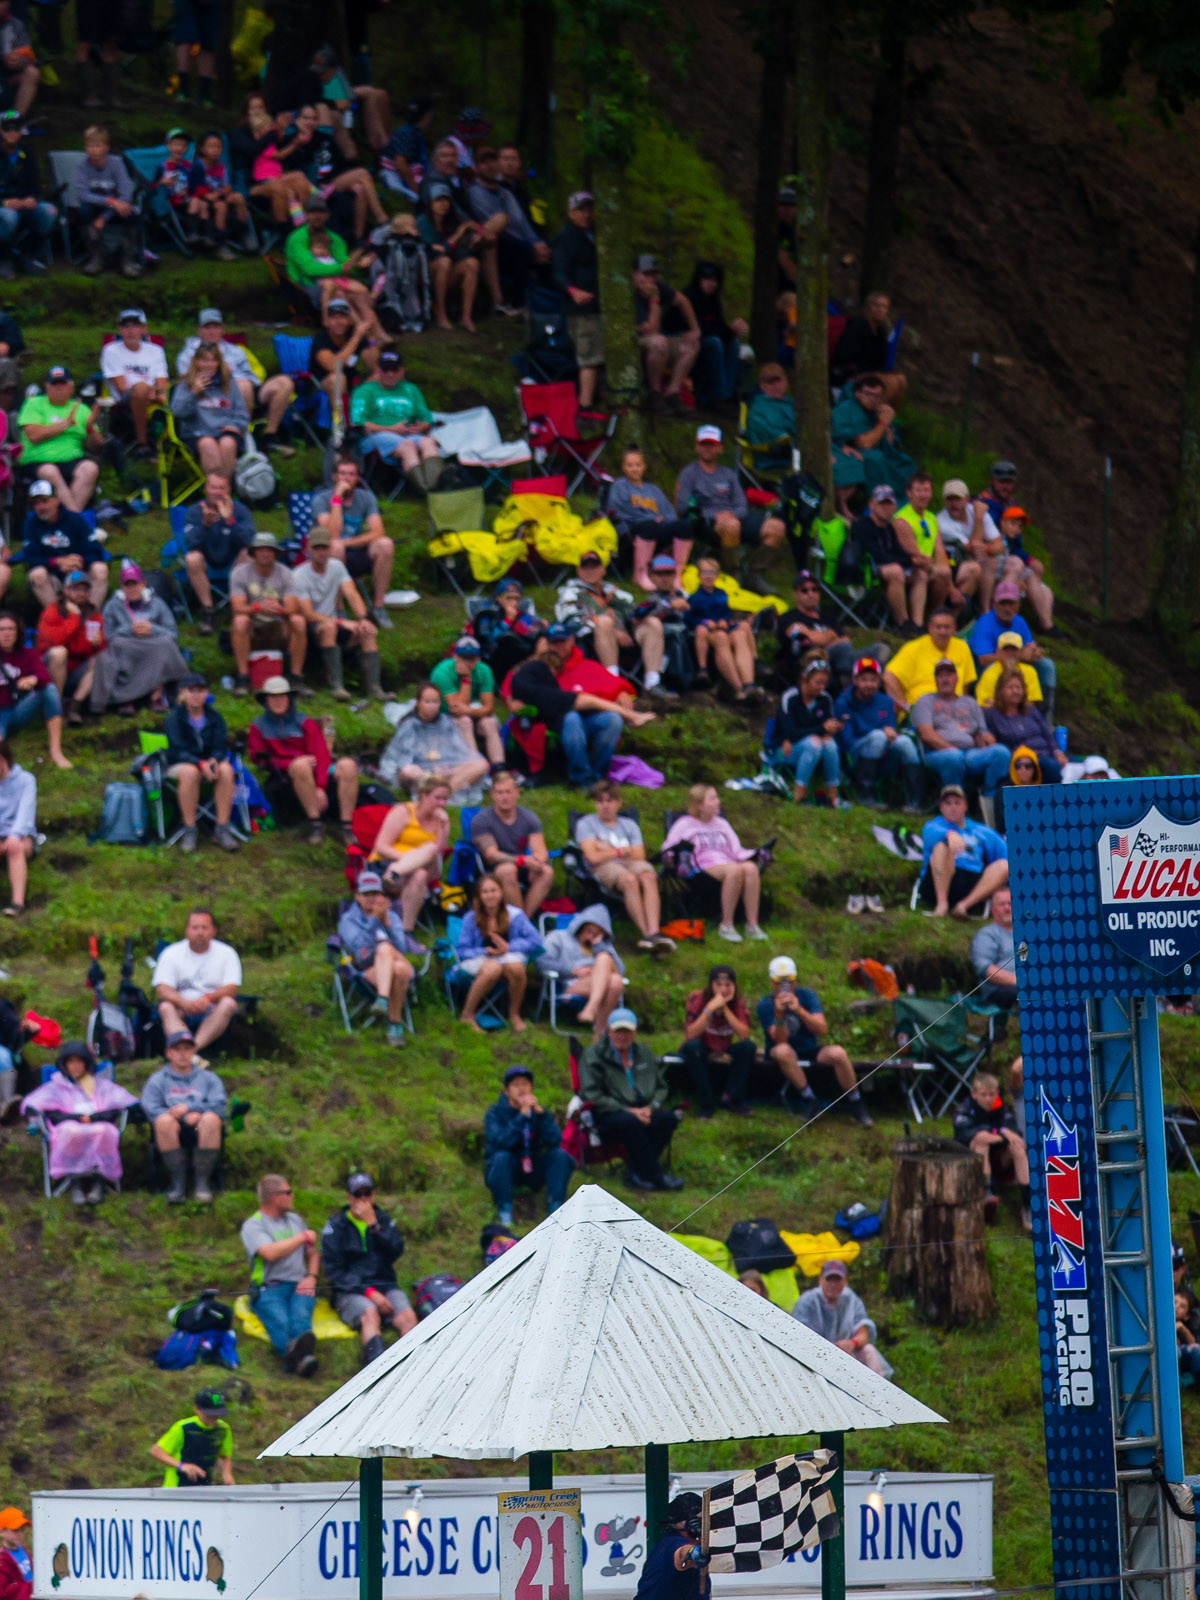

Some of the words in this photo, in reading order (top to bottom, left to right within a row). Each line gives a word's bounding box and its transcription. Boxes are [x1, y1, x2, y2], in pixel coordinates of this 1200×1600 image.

[1113, 858, 1200, 900] LUCAS
[1160, 843, 1200, 854] PERFORMA
[1108, 912, 1133, 931] OIL
[1149, 938, 1181, 957] INC.
[1039, 1083, 1088, 1292] AMA
[1053, 1299, 1072, 1407] RACING
[1065, 1299, 1095, 1407] PRO
[512, 1494, 545, 1504] Spring
[549, 1492, 578, 1502] Creek
[526, 1500, 577, 1509] MOTOCROSS
[71, 1516, 135, 1581] ONION
[141, 1517, 204, 1583] RINGS
[318, 1516, 460, 1580] CHESE
[512, 1515, 570, 1600] 21
[859, 1500, 964, 1561] RINGS
